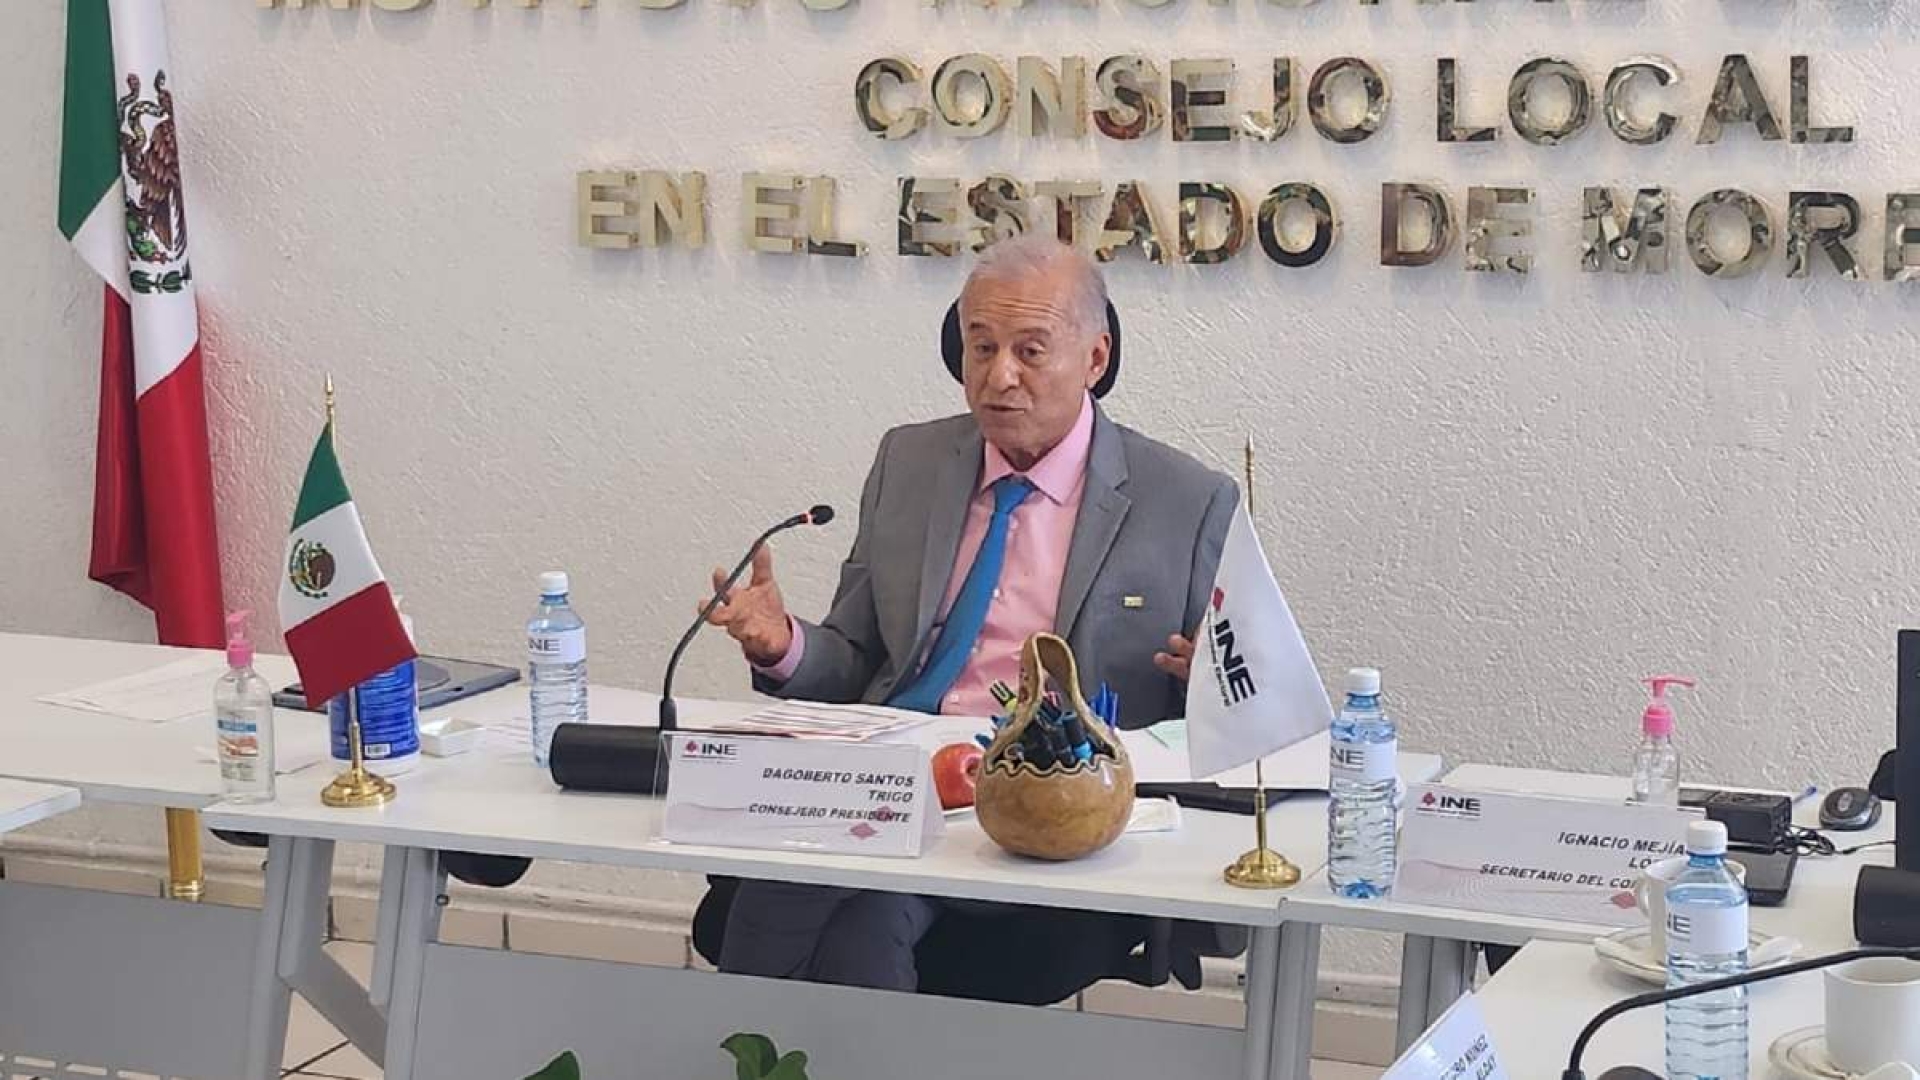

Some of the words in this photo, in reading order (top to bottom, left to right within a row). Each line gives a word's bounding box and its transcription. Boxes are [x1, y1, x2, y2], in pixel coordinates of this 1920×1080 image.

[854, 54, 1391, 144] CONSEJO
[1436, 54, 1855, 145] LOCAL
[576, 170, 706, 249] EN
[742, 172, 869, 258] EL
[898, 172, 1344, 269] ESTADO
[1381, 182, 1537, 274] DE
[528, 638, 561, 652] NE
[1215, 618, 1257, 703] INE
[702, 743, 737, 756] INE
[1331, 746, 1364, 766] NE
[763, 767, 852, 784] DAGOBERTO
[855, 773, 915, 787] SANTOS
[868, 790, 913, 802] TRIGO
[1440, 796, 1481, 812] INE
[749, 803, 827, 818] CONSEJERO
[830, 809, 911, 823] PRESIDENTE
[1559, 832, 1629, 850] IGNACIO
[1480, 864, 1572, 883] SECRETARIO
[1576, 874, 1604, 886] DEL
